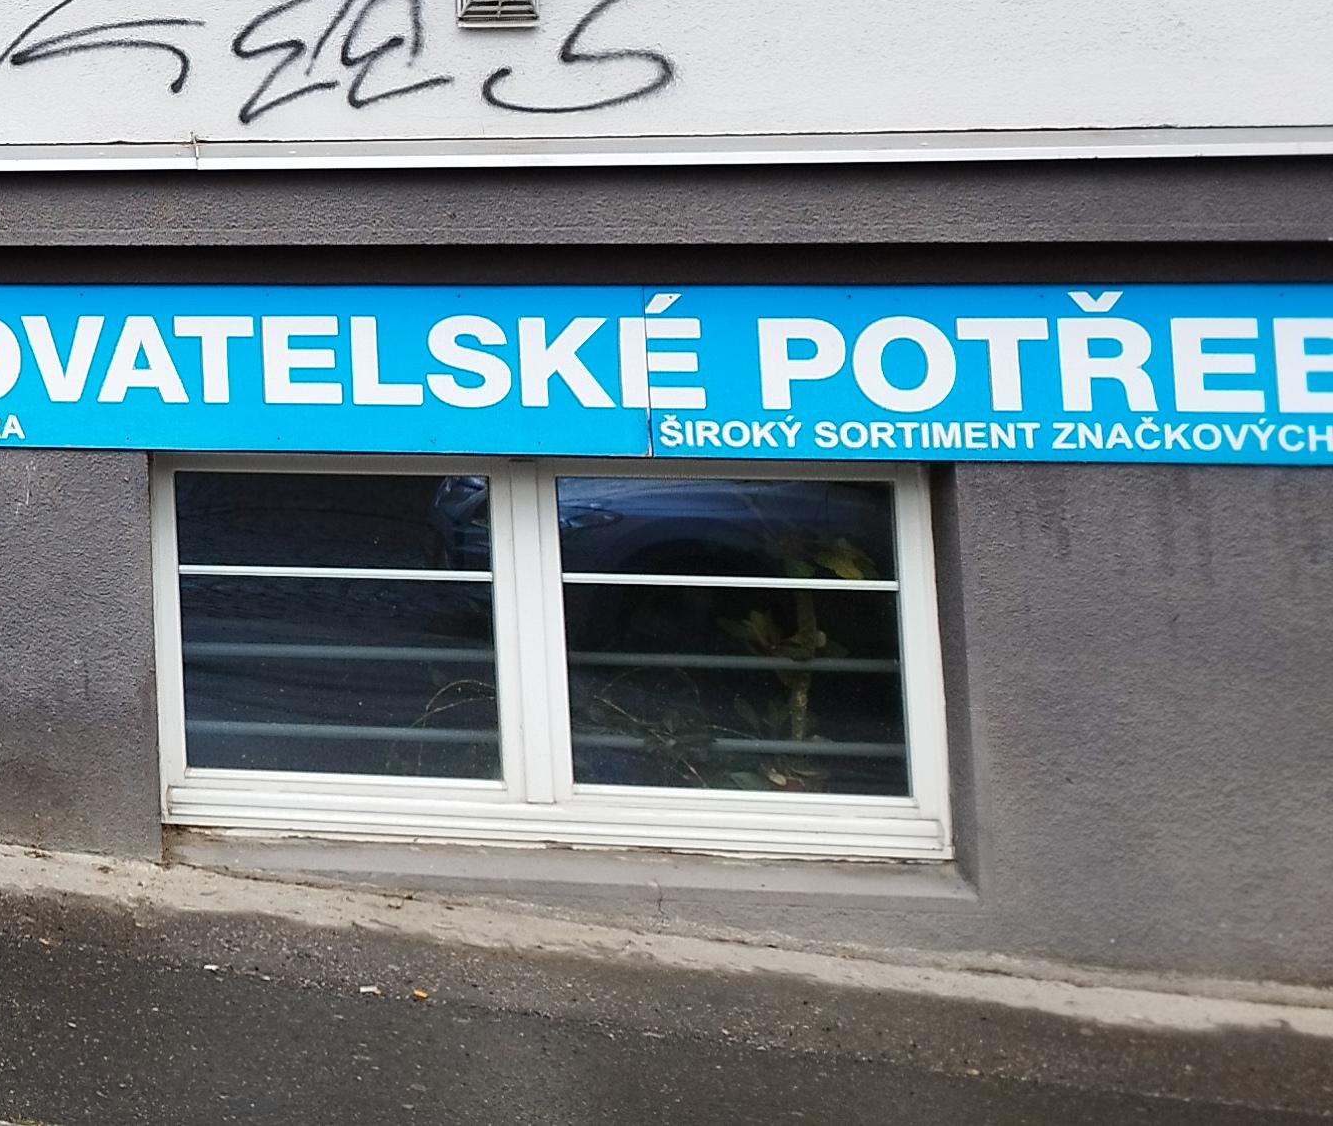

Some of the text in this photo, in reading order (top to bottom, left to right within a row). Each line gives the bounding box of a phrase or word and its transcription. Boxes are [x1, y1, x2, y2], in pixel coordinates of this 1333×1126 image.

[659, 415, 1333, 452] ŠIROKÝ SORTIMENT ZNAČKOVÝCH
